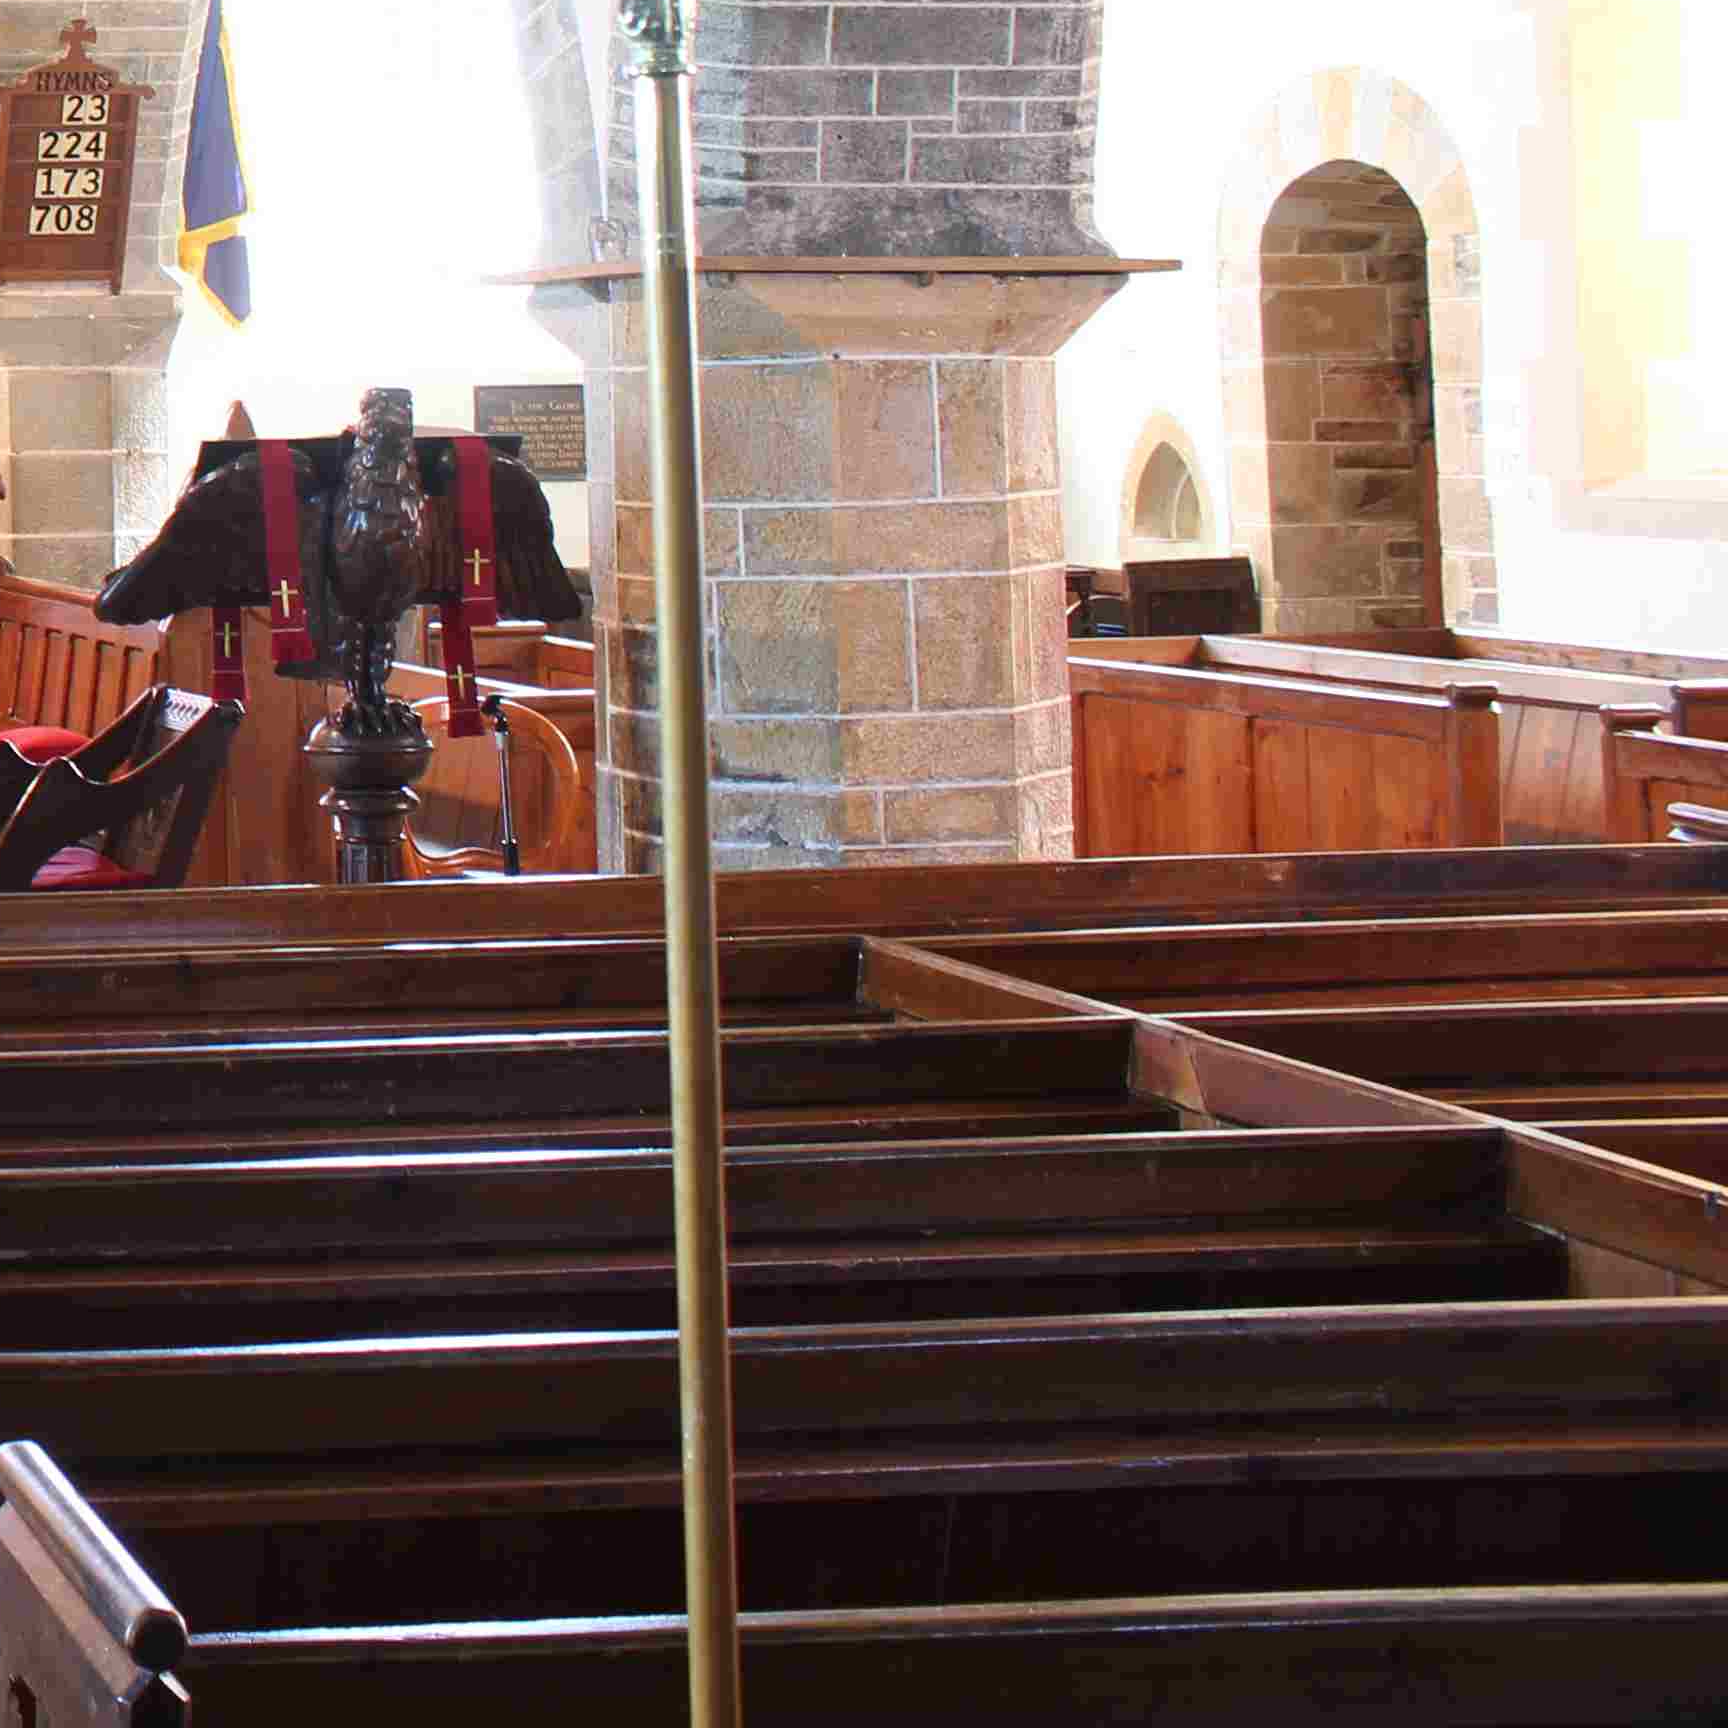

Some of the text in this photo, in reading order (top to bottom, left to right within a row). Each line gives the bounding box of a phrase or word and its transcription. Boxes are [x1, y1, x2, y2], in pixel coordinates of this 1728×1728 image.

[36, 71, 112, 93] HYMNS
[67, 95, 106, 122] 23
[42, 132, 103, 159] 224
[41, 168, 100, 195] 173
[34, 204, 94, 232] 708
